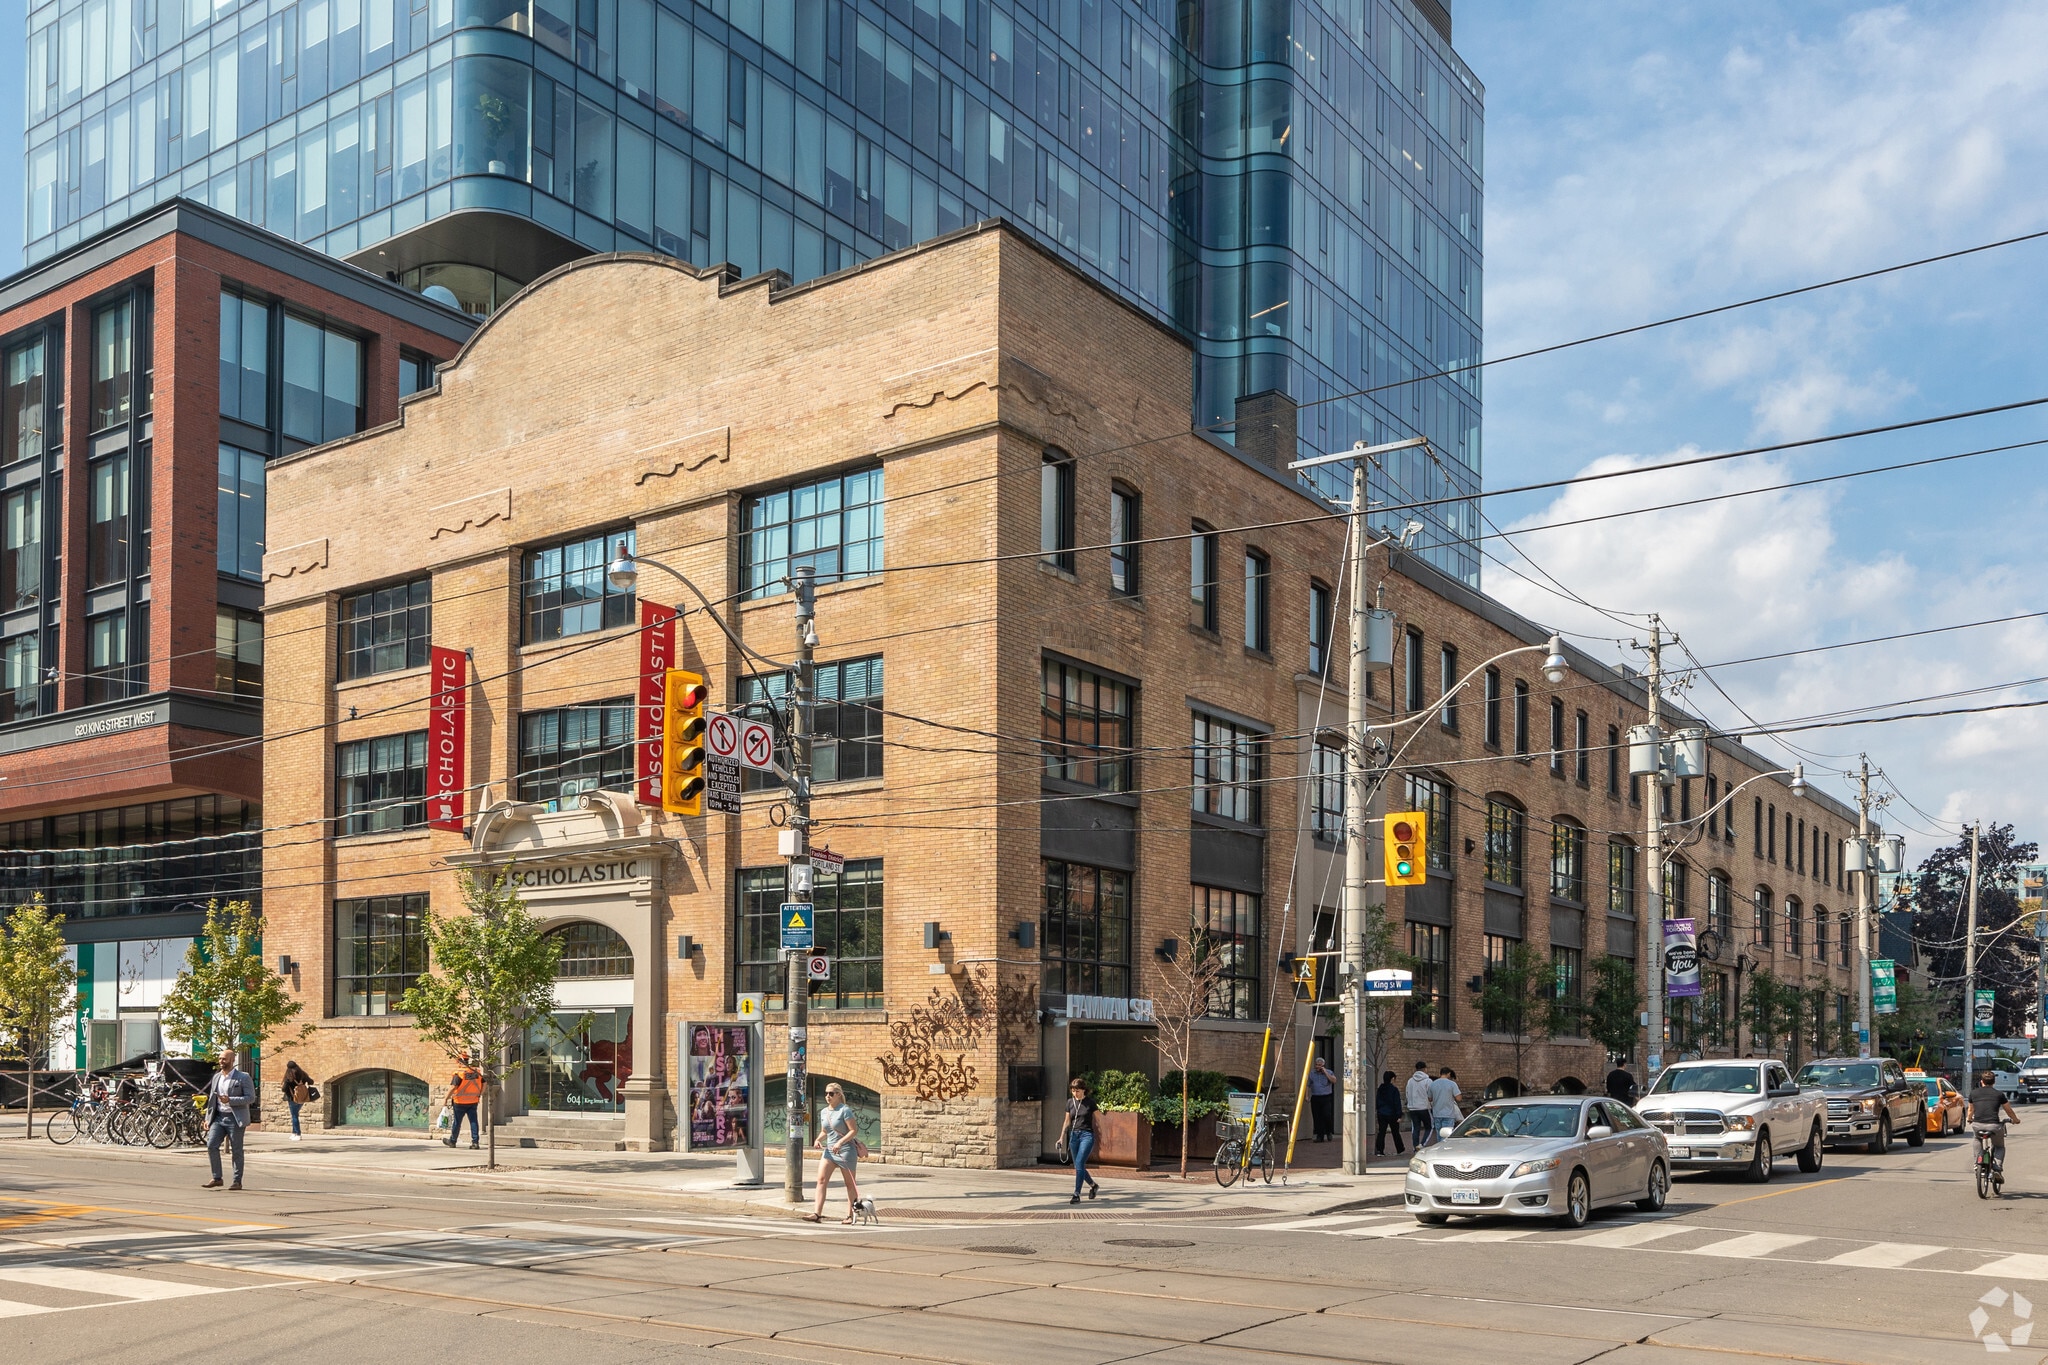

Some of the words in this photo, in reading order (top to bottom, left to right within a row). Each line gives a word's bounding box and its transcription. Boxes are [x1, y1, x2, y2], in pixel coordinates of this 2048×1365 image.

[650, 613, 665, 776] SCHOLASTIC
[75, 723, 88, 737] 620
[88, 720, 105, 734] KING
[105, 714, 133, 731] STREET
[133, 710, 155, 726] WEST
[439, 656, 456, 801] SCHOLASTIC
[708, 754, 739, 767] AUTHORIZED
[711, 763, 736, 775] VEHICLES
[708, 771, 718, 780] AND
[719, 773, 740, 784] BICYCLES
[711, 780, 737, 792] EXCEPTED
[720, 793, 741, 803] EXCEPTED
[811, 850, 828, 859] Fashion
[812, 858, 834, 871] PORTLAND
[834, 864, 841, 872] ST
[511, 861, 637, 887] SCHOLASTIC
[1672, 960, 1694, 975] you
[1373, 981, 1389, 991] King
[1396, 981, 1403, 989] W
[1066, 994, 1129, 1021] HAMMAM
[715, 1028, 726, 1144] HUSTLERS
[566, 1093, 581, 1105] 604
